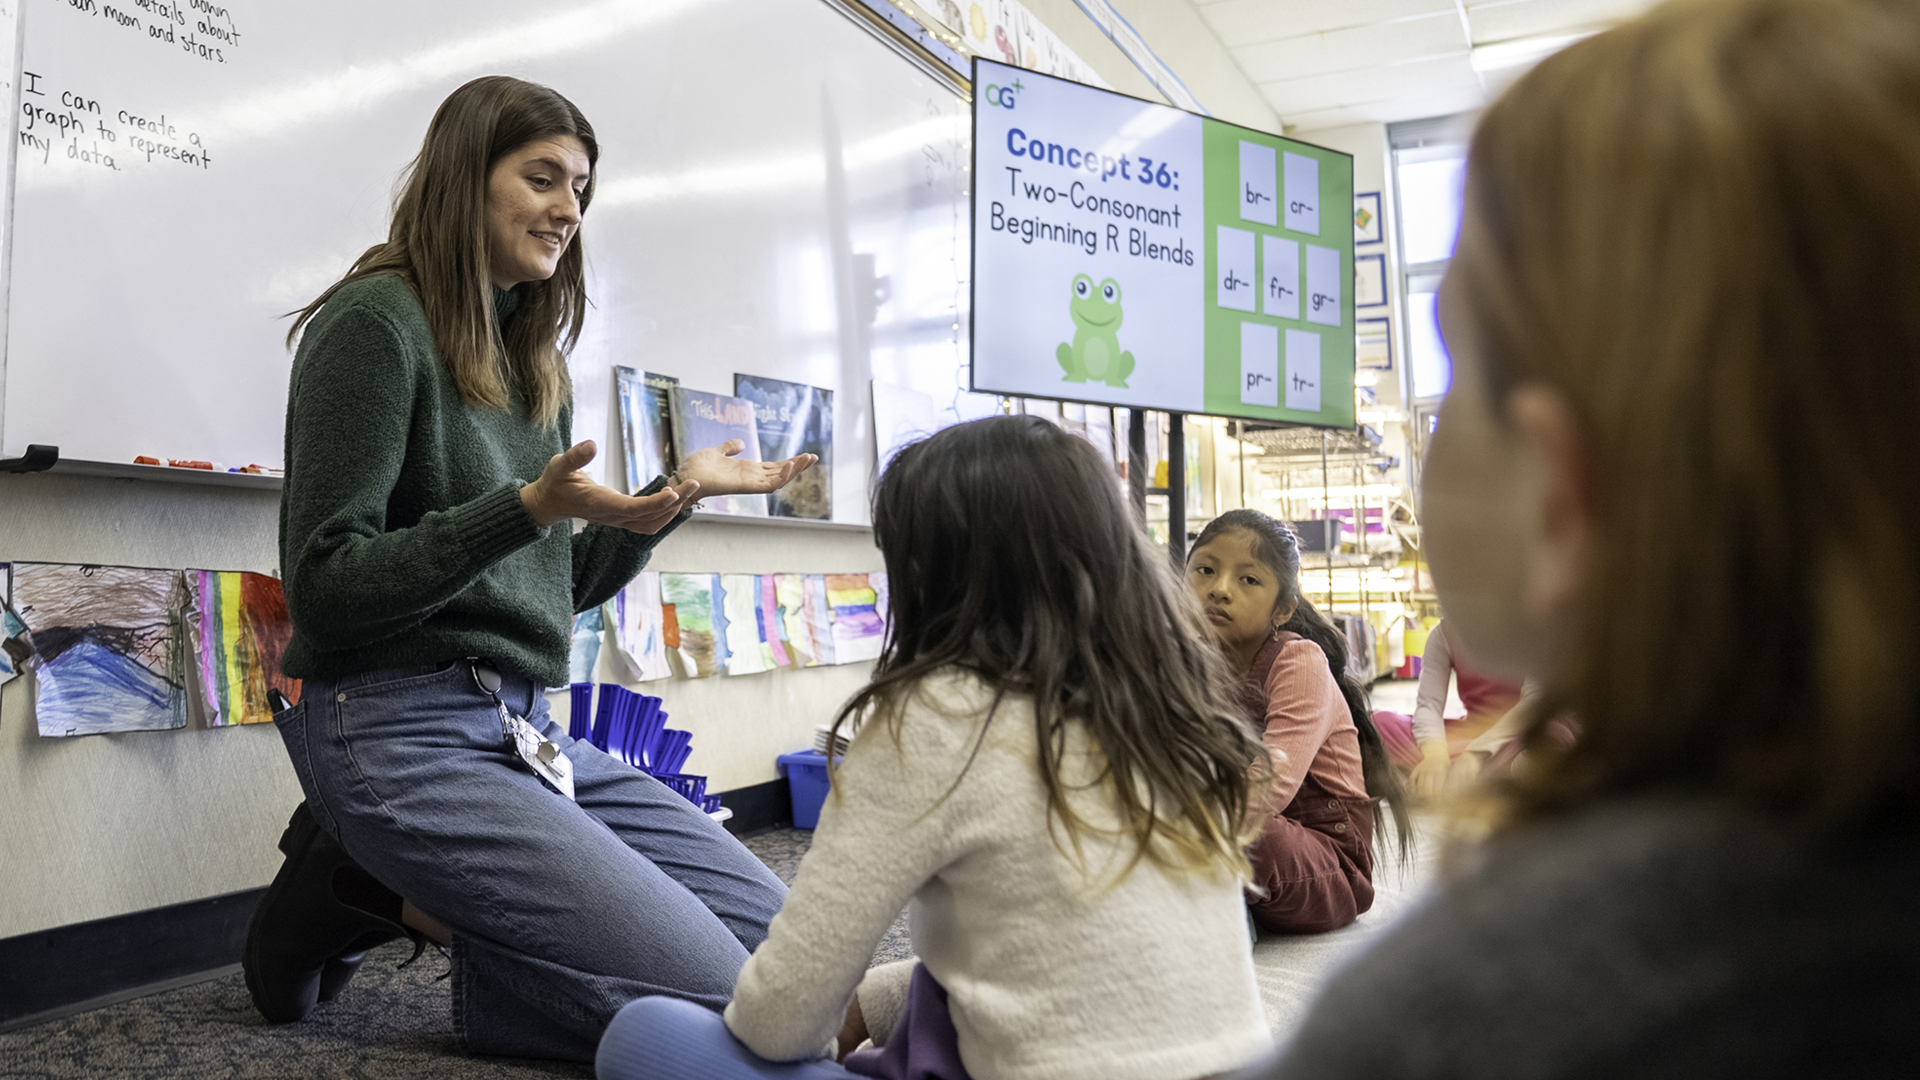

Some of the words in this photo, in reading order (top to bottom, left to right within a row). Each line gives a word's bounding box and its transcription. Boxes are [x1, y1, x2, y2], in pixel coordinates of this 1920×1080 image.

[103, 5, 141, 31] moon
[149, 23, 175, 44] and
[181, 32, 228, 64] stars.
[197, 16, 241, 47] about
[24, 71, 45, 96] I
[61, 90, 101, 115] can
[118, 109, 176, 141] create
[188, 132, 202, 149] a
[20, 130, 50, 164] my
[67, 137, 121, 171] data.
[23, 102, 84, 138] graph
[97, 120, 116, 143] to
[129, 134, 211, 169] represent
[1007, 127, 1131, 182] Concept
[1137, 156, 1179, 191] 36:
[1005, 166, 1181, 229] Two-Consonant
[1246, 182, 1271, 205] br-
[1290, 200, 1314, 215] cr-
[990, 201, 1097, 255] Beginning
[1106, 223, 1119, 253] R
[1129, 227, 1195, 267] Blends
[1224, 269, 1250, 291] dr-
[1269, 276, 1294, 299] fr-
[1312, 293, 1335, 311] gr-
[1246, 372, 1272, 391] pr-
[1292, 373, 1315, 392] tr-
